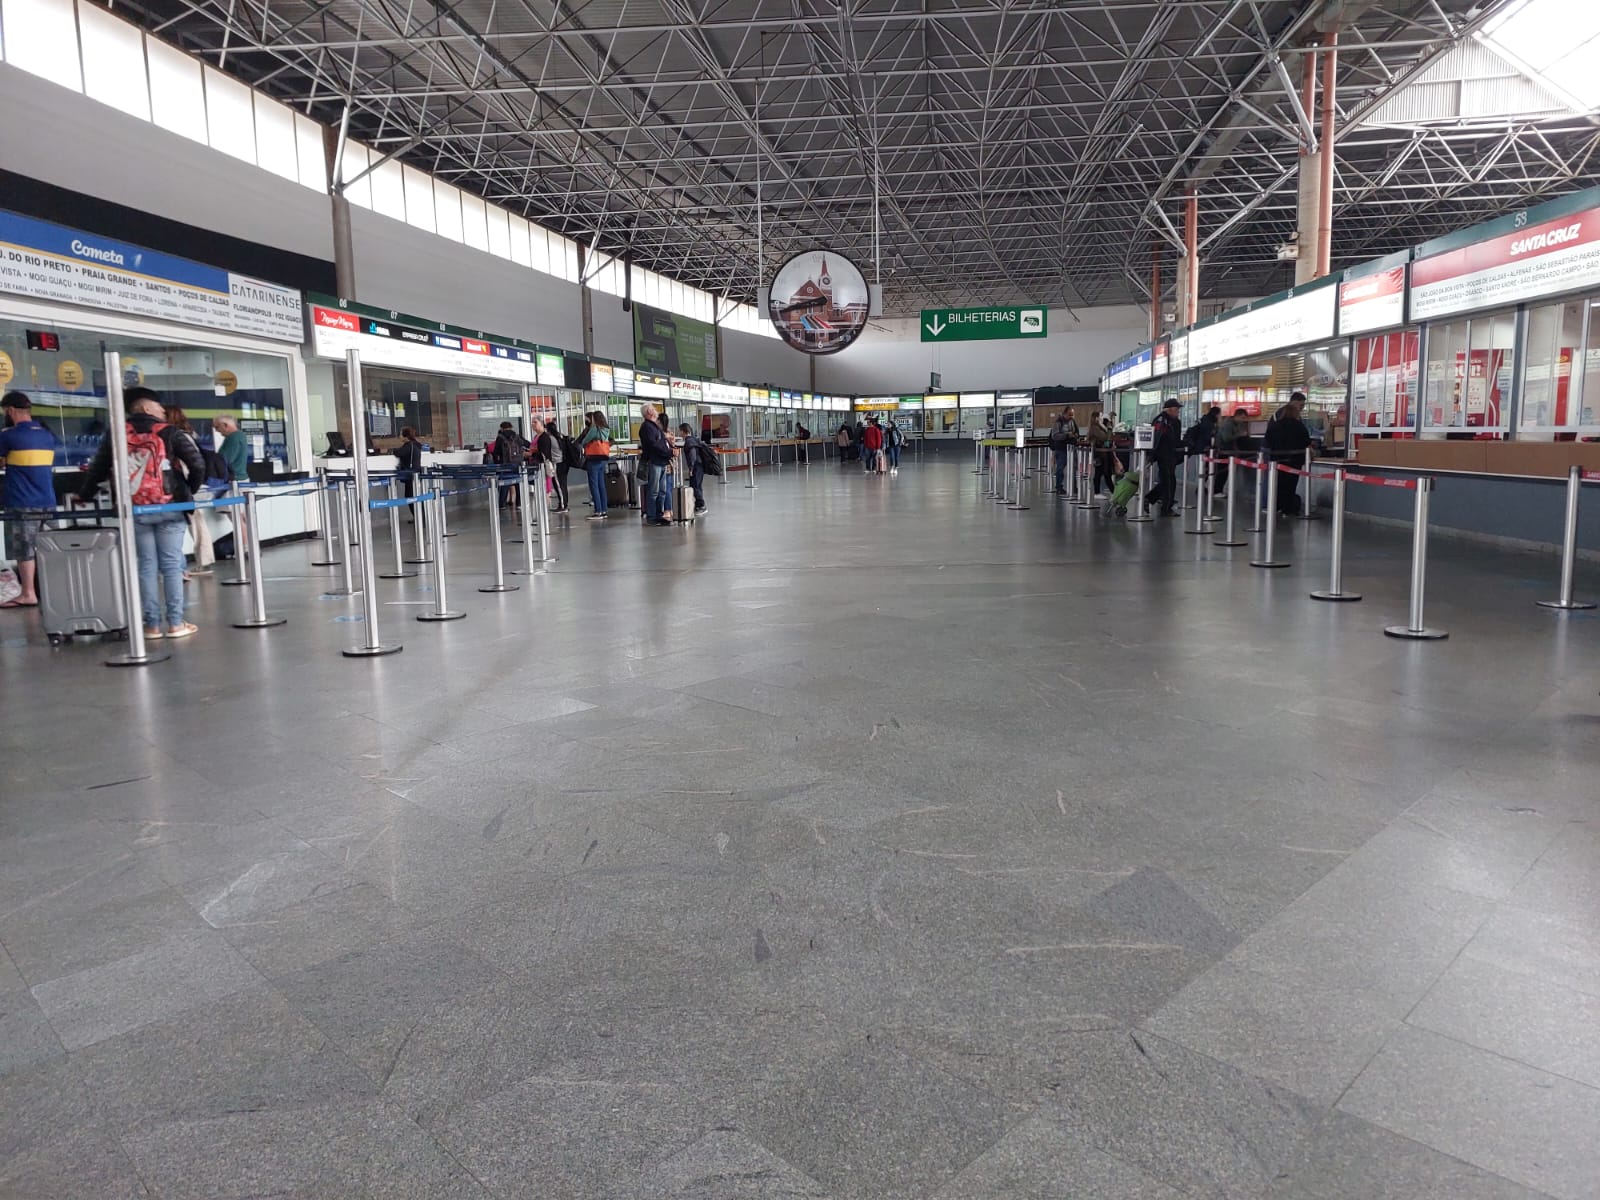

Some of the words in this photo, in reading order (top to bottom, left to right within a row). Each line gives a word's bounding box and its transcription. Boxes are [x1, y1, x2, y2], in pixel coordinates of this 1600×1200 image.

[71, 239, 124, 266] Cometa
[1510, 234, 1546, 256] SANTA
[1547, 223, 1582, 246] CRUZ
[1, 266, 22, 278] VISTA
[29, 272, 47, 283] MOGI
[48, 276, 72, 288] GUAÇU
[78, 282, 95, 292] MOGI
[9, 251, 22, 262] DO
[25, 256, 41, 266] RIO
[44, 260, 72, 273] PRETO
[82, 267, 106, 280] PRAIA
[107, 273, 137, 287] GRANDE
[145, 281, 171, 294] SANTOS
[208, 295, 230, 306] CALDAS
[1536, 262, 1547, 271] SÃO
[1561, 264, 1582, 274] CAMPO
[231, 283, 301, 310] CATARINENSE
[948, 310, 1017, 323] BILHETERIAS
[682, 382, 701, 391] PRATA
